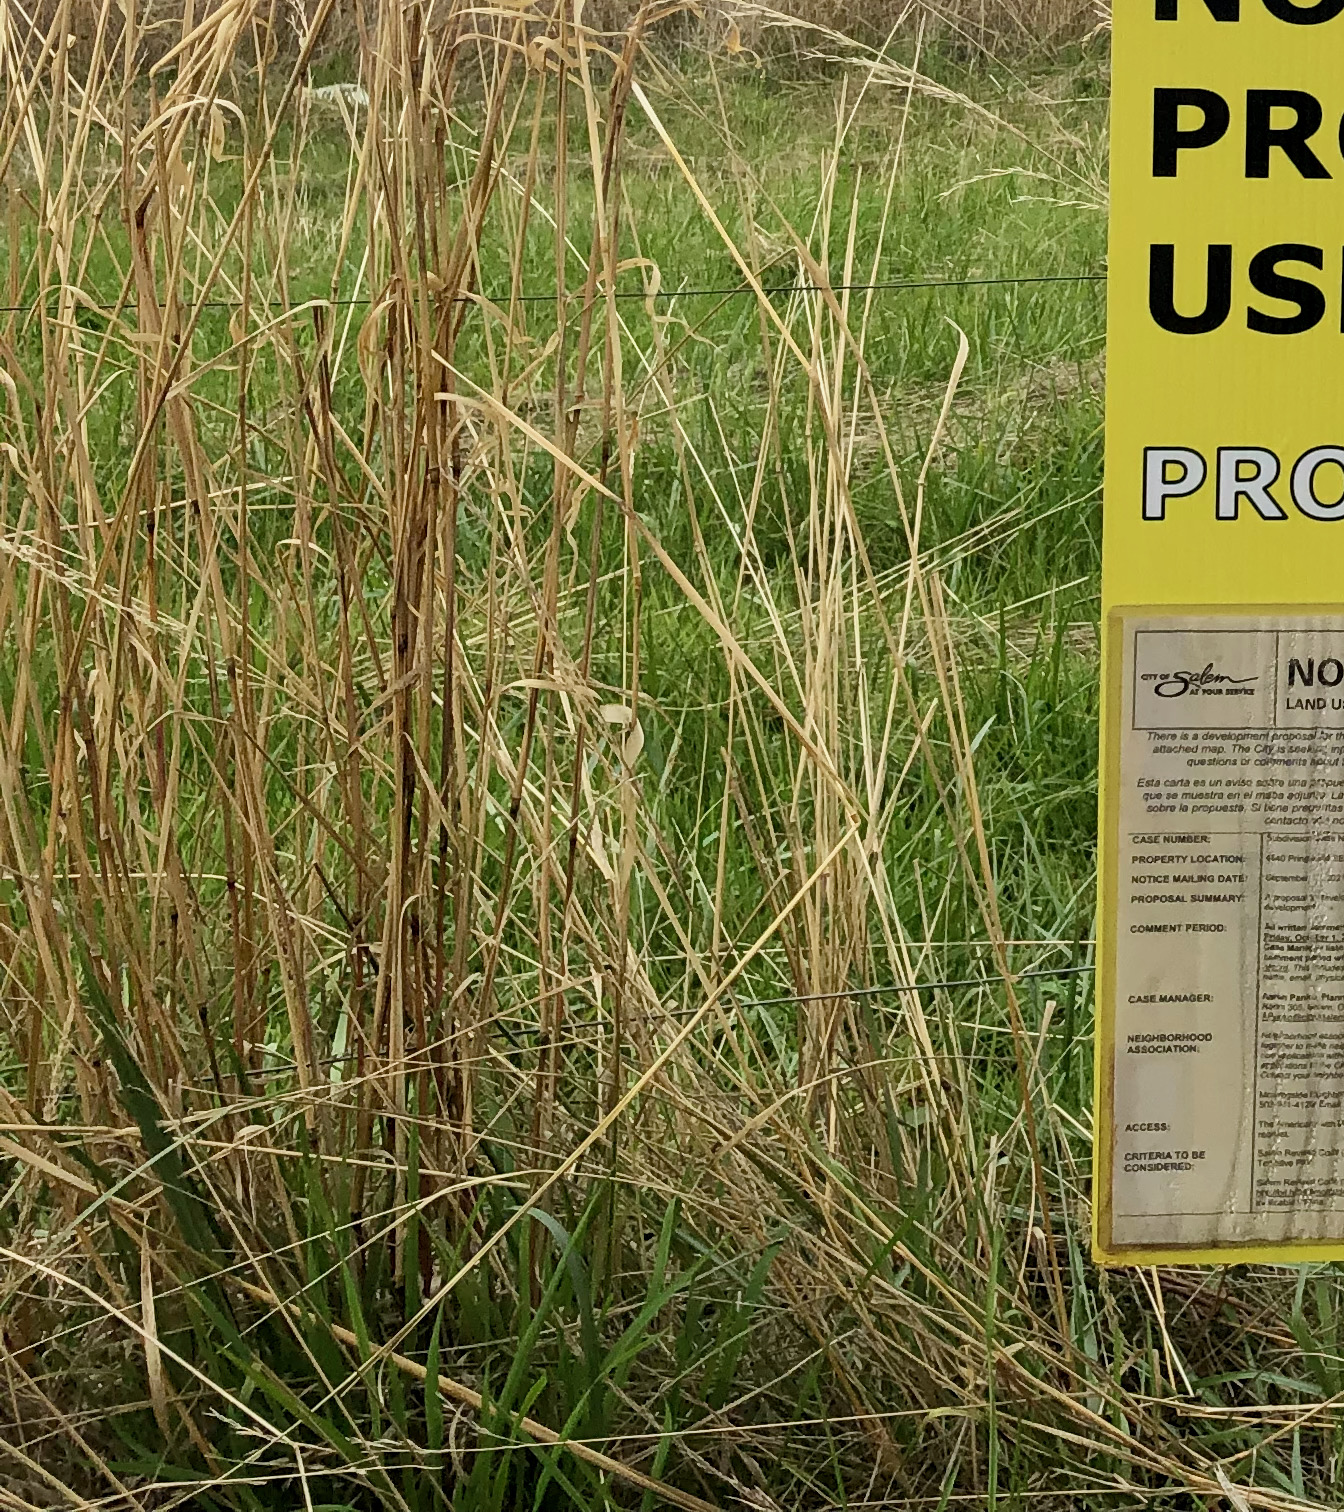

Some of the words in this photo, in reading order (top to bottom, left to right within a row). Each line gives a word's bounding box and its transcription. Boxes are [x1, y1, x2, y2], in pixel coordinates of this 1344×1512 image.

[1154, 663, 1258, 697] Salem
[1286, 699, 1326, 710] LAND
[1148, 732, 1177, 741] There
[1180, 732, 1189, 740] is
[1202, 731, 1269, 742] development
[1153, 745, 1198, 753] attached
[1202, 746, 1226, 755] map.
[1232, 744, 1250, 753] The
[1187, 758, 1237, 767] questions
[1138, 778, 1160, 787] Esta
[1164, 779, 1190, 787] carta
[1143, 792, 1162, 801] que
[1182, 791, 1223, 800] muestra
[1227, 792, 1240, 800] en
[1147, 804, 1176, 812] sobre
[1179, 804, 1188, 812] la
[1265, 817, 1308, 825] contacto
[1132, 836, 1160, 844] CASE
[1163, 836, 1210, 844] NUMBER:
[1132, 856, 1187, 864] PROPERTY
[1190, 855, 1245, 863] LOCATION:
[1132, 875, 1169, 883] NOTICE
[1173, 875, 1214, 883] MAILING
[1131, 895, 1187, 903] PROPOSAL
[1190, 894, 1245, 902] SUMMARY:
[1185, 924, 1227, 932] PERIOD:
[1128, 995, 1157, 1003] CASE
[1159, 994, 1213, 1003] MANAGER:
[1127, 1033, 1213, 1042] NEIGHBORHOOD
[1127, 1044, 1200, 1053] ASSOCIATION:
[1125, 1122, 1171, 1132] ACCESS:
[1124, 1152, 1173, 1161] CRITERIA
[1175, 1151, 1189, 1159] TO
[1192, 1151, 1206, 1159] BE
[1124, 1163, 1195, 1172] CONSIDERED:
